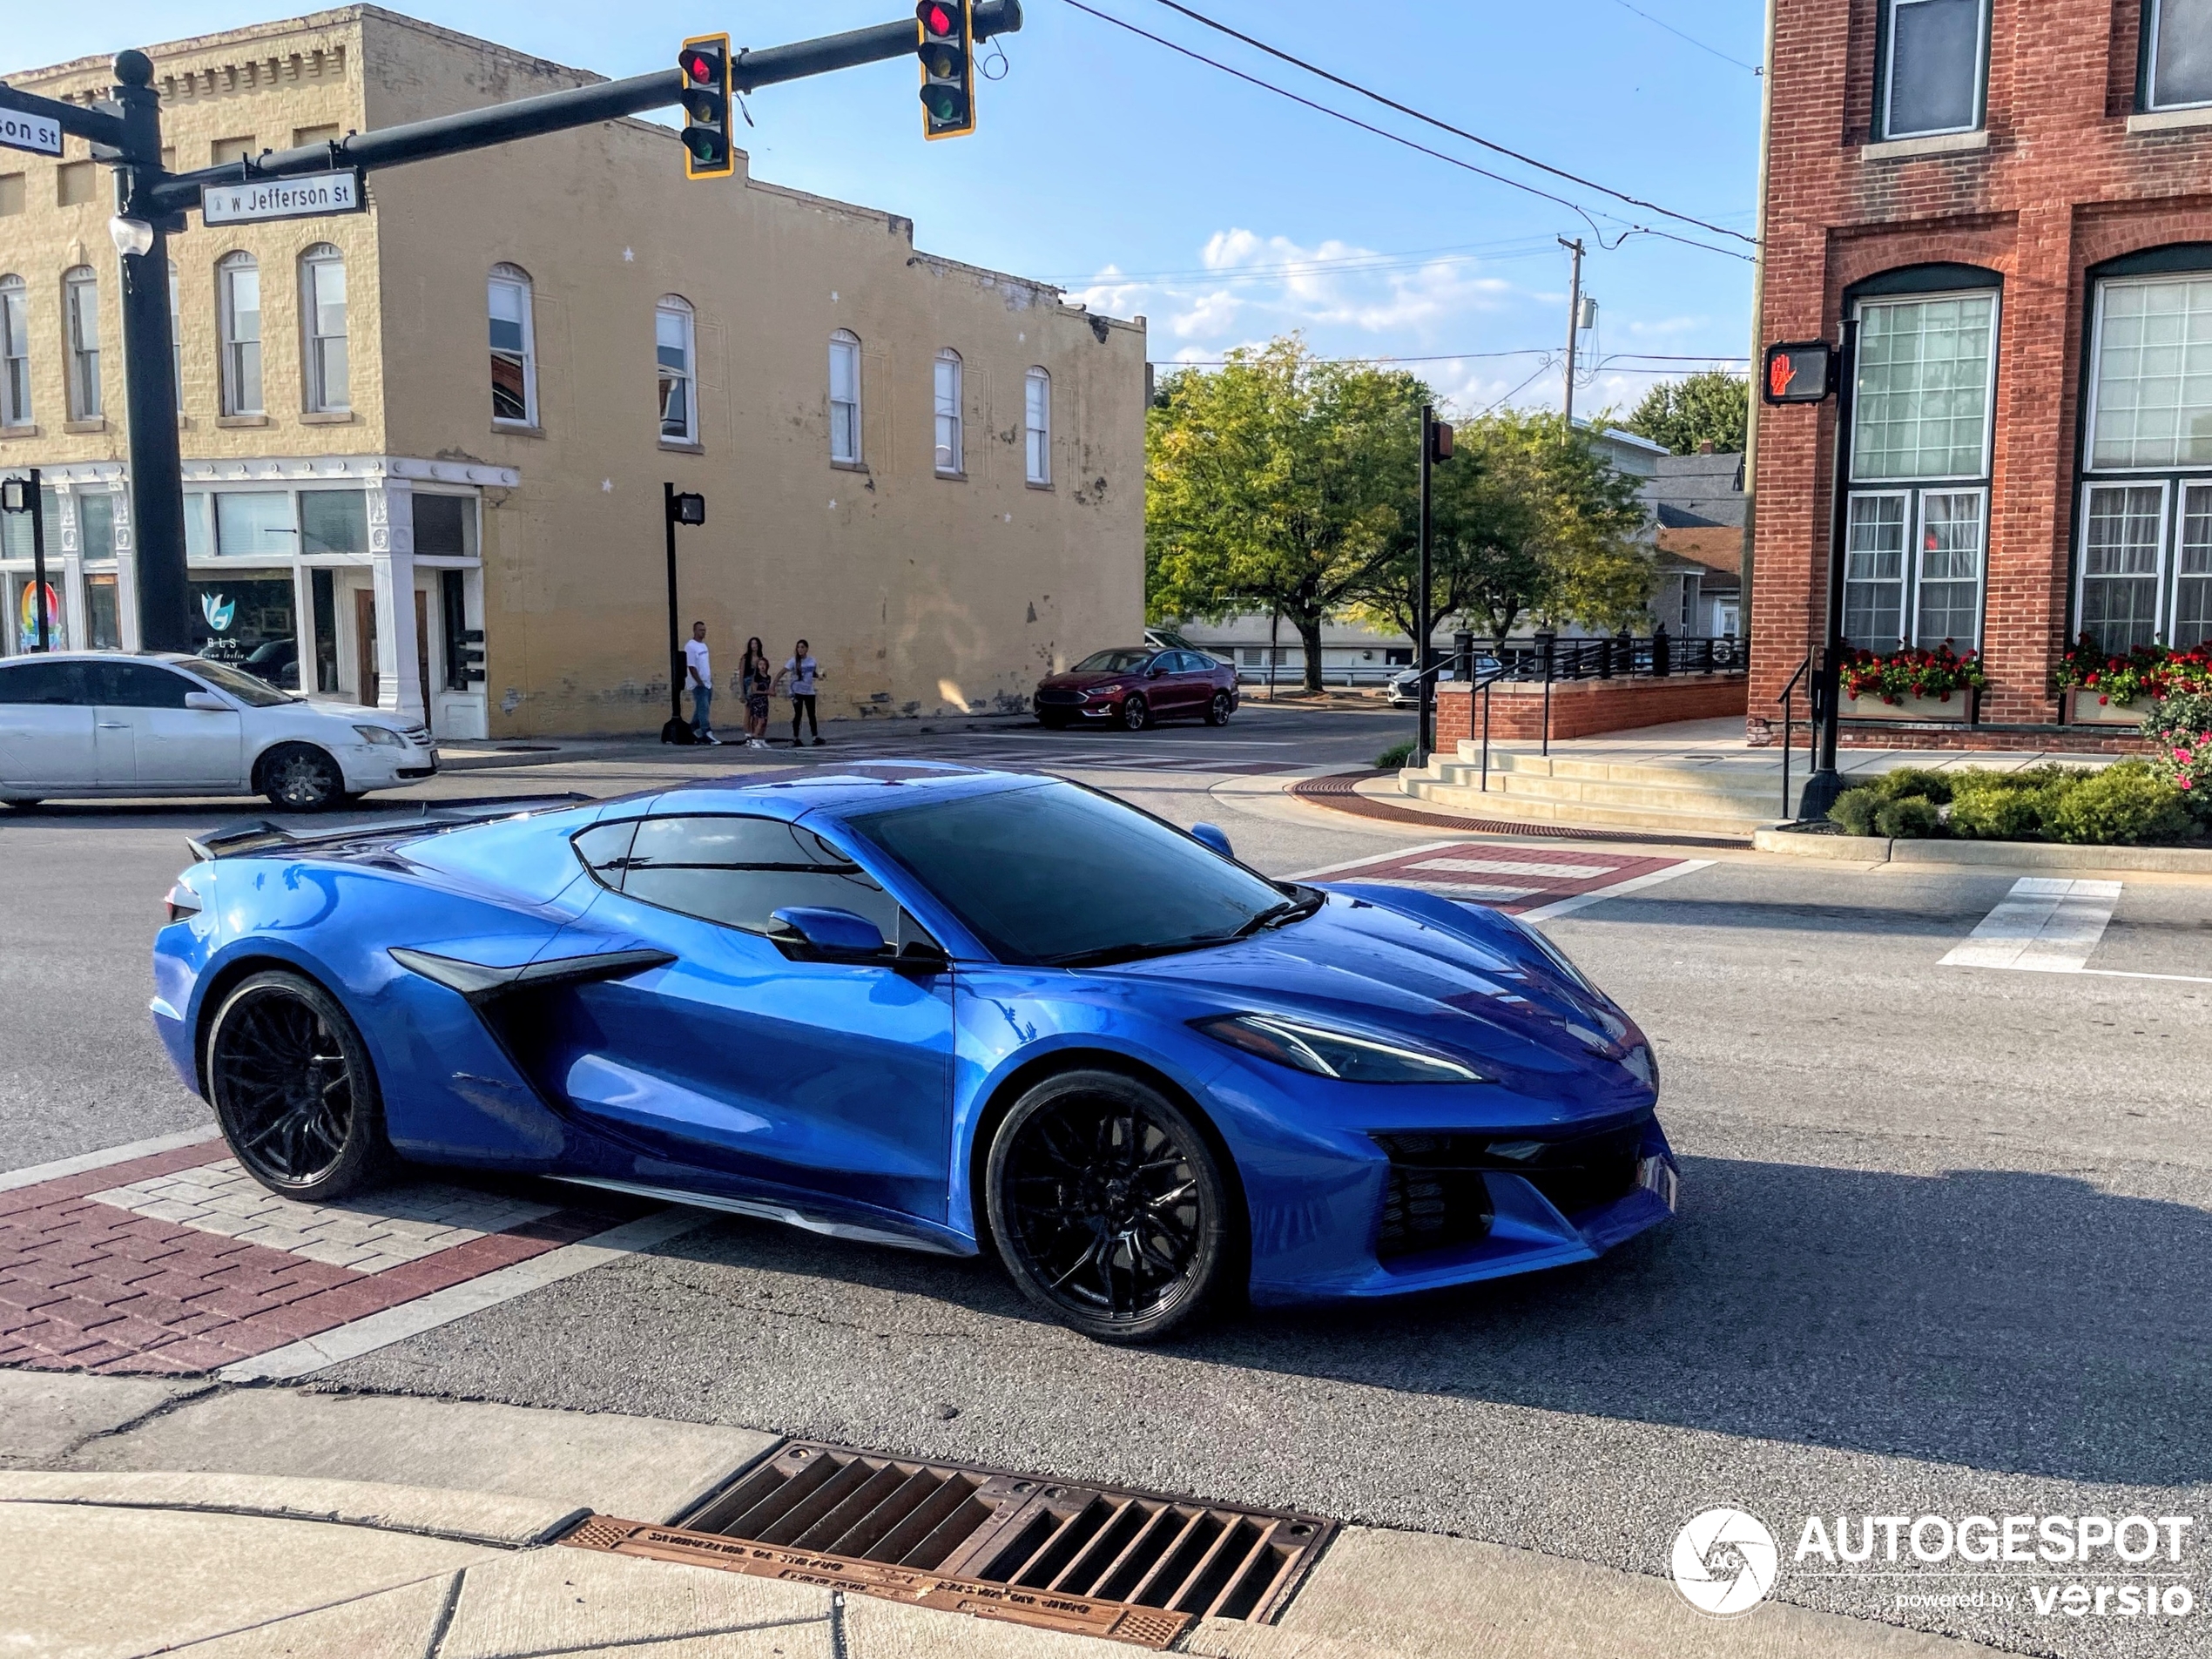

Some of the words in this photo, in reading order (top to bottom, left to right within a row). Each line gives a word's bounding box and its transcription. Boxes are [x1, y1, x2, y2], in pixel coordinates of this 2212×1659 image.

[38, 128, 57, 145] St
[232, 197, 241, 212] W
[248, 187, 328, 211] Jefferson
[334, 185, 349, 202] St
